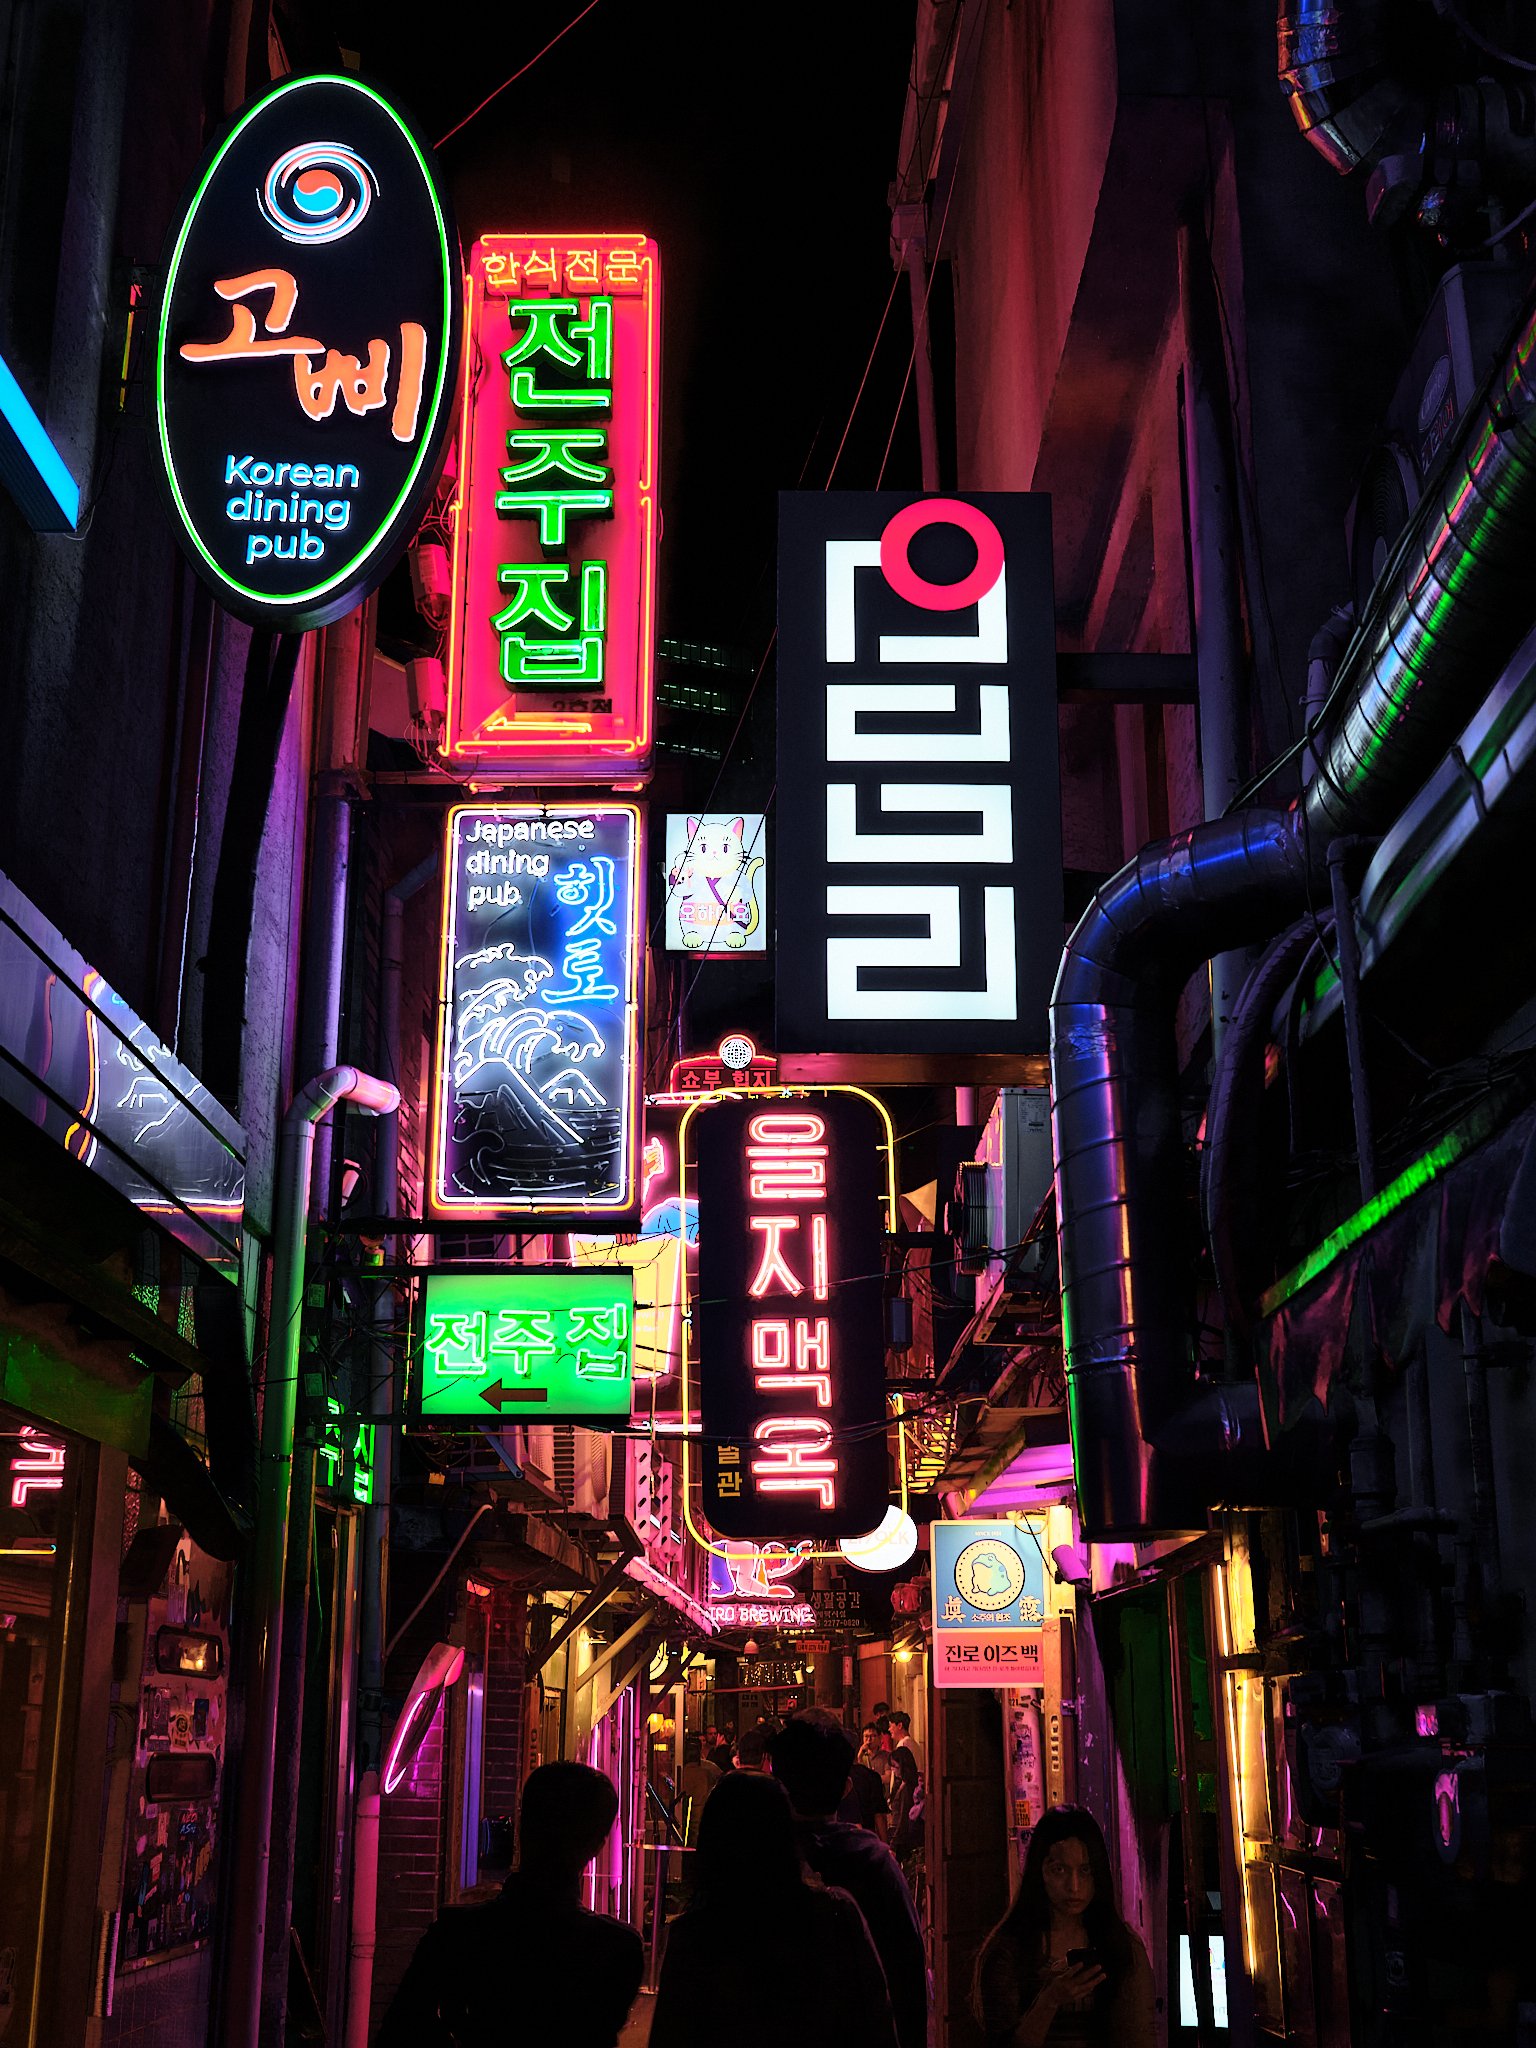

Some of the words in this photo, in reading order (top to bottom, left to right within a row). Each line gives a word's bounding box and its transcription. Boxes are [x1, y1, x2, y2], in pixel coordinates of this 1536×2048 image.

[179, 268, 427, 442] 고삐
[223, 455, 360, 491] Korean
[225, 489, 351, 531] dining
[490, 296, 613, 690] 전주집
[245, 528, 325, 565] pub
[465, 818, 596, 848] Japanese
[465, 849, 551, 879] dining
[468, 880, 524, 911] pub
[679, 904, 750, 924] 오하이요
[681, 1070, 722, 1091] 쇼부
[745, 1113, 839, 1511] 을지맥옥
[426, 1303, 628, 1380] 전주집
[738, 1607, 815, 1625] BREWING
